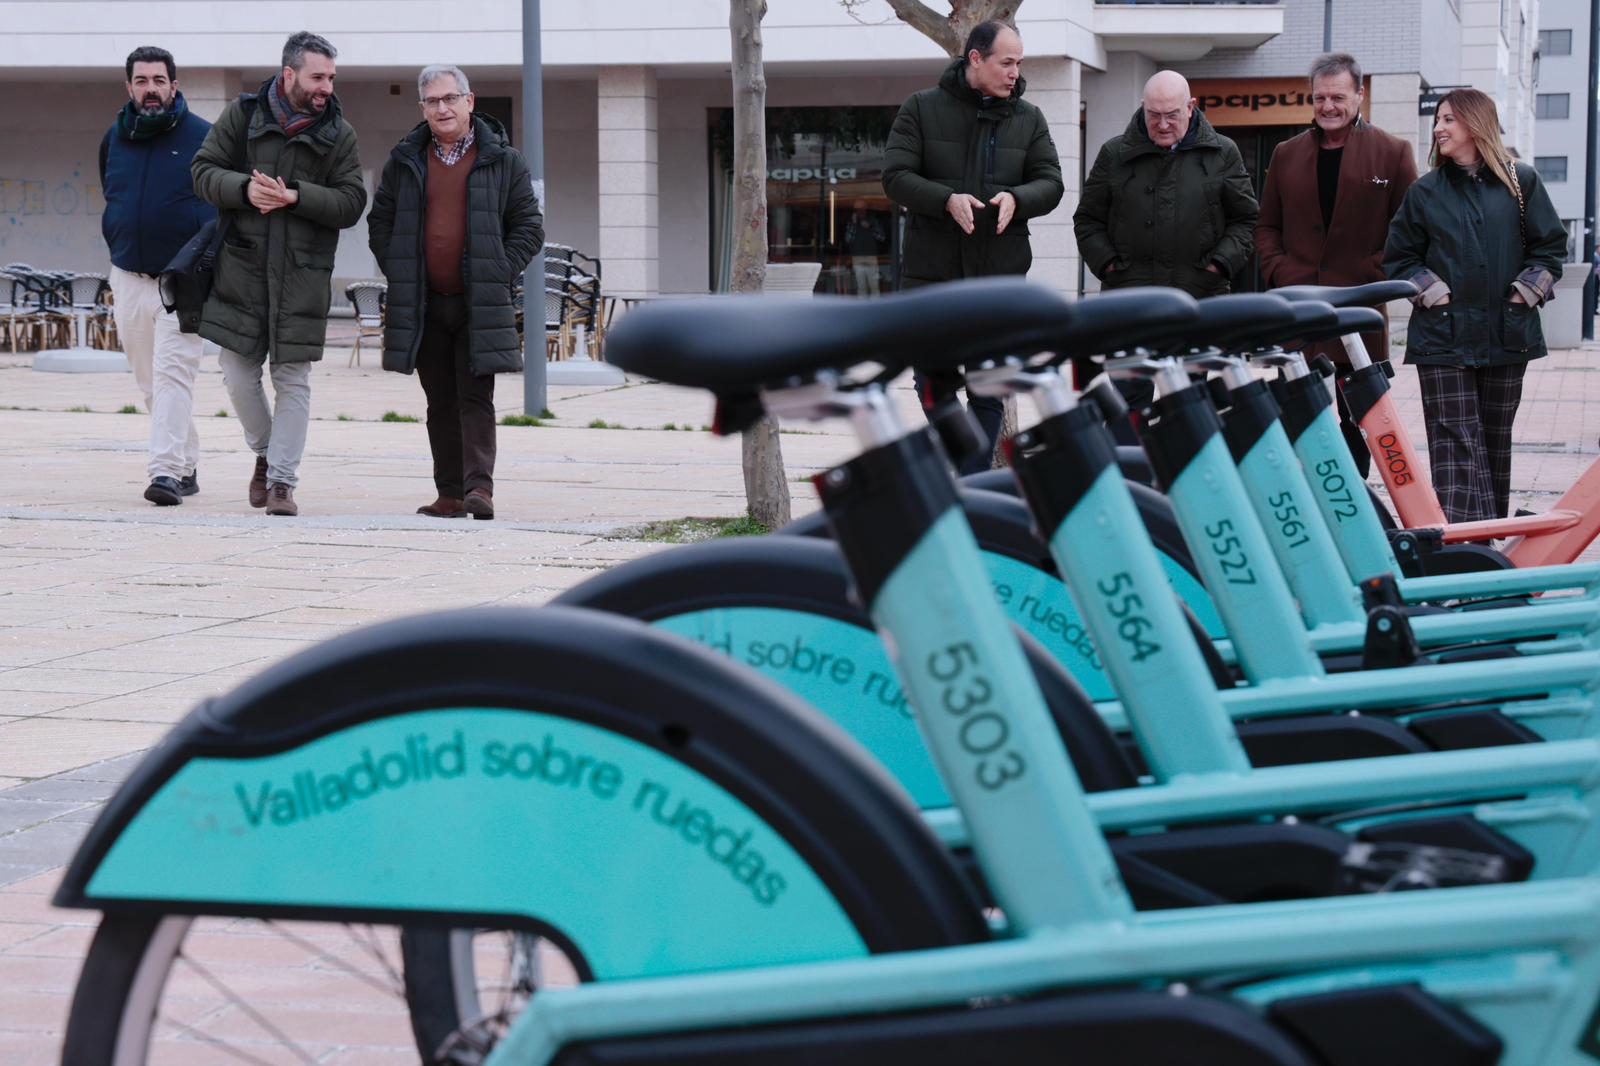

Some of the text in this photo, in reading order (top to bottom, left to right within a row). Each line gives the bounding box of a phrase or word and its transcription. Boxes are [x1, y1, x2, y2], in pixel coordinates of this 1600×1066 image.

[1316, 459, 1358, 523] 5072
[1378, 433, 1413, 486] 0405
[1205, 519, 1256, 585] 5527
[1268, 491, 1310, 548] 5561
[1097, 572, 1161, 662] 5564
[747, 635, 856, 685] sobre
[927, 641, 1027, 790] 5303
[234, 729, 788, 905] Valladolid sobre ruedas
